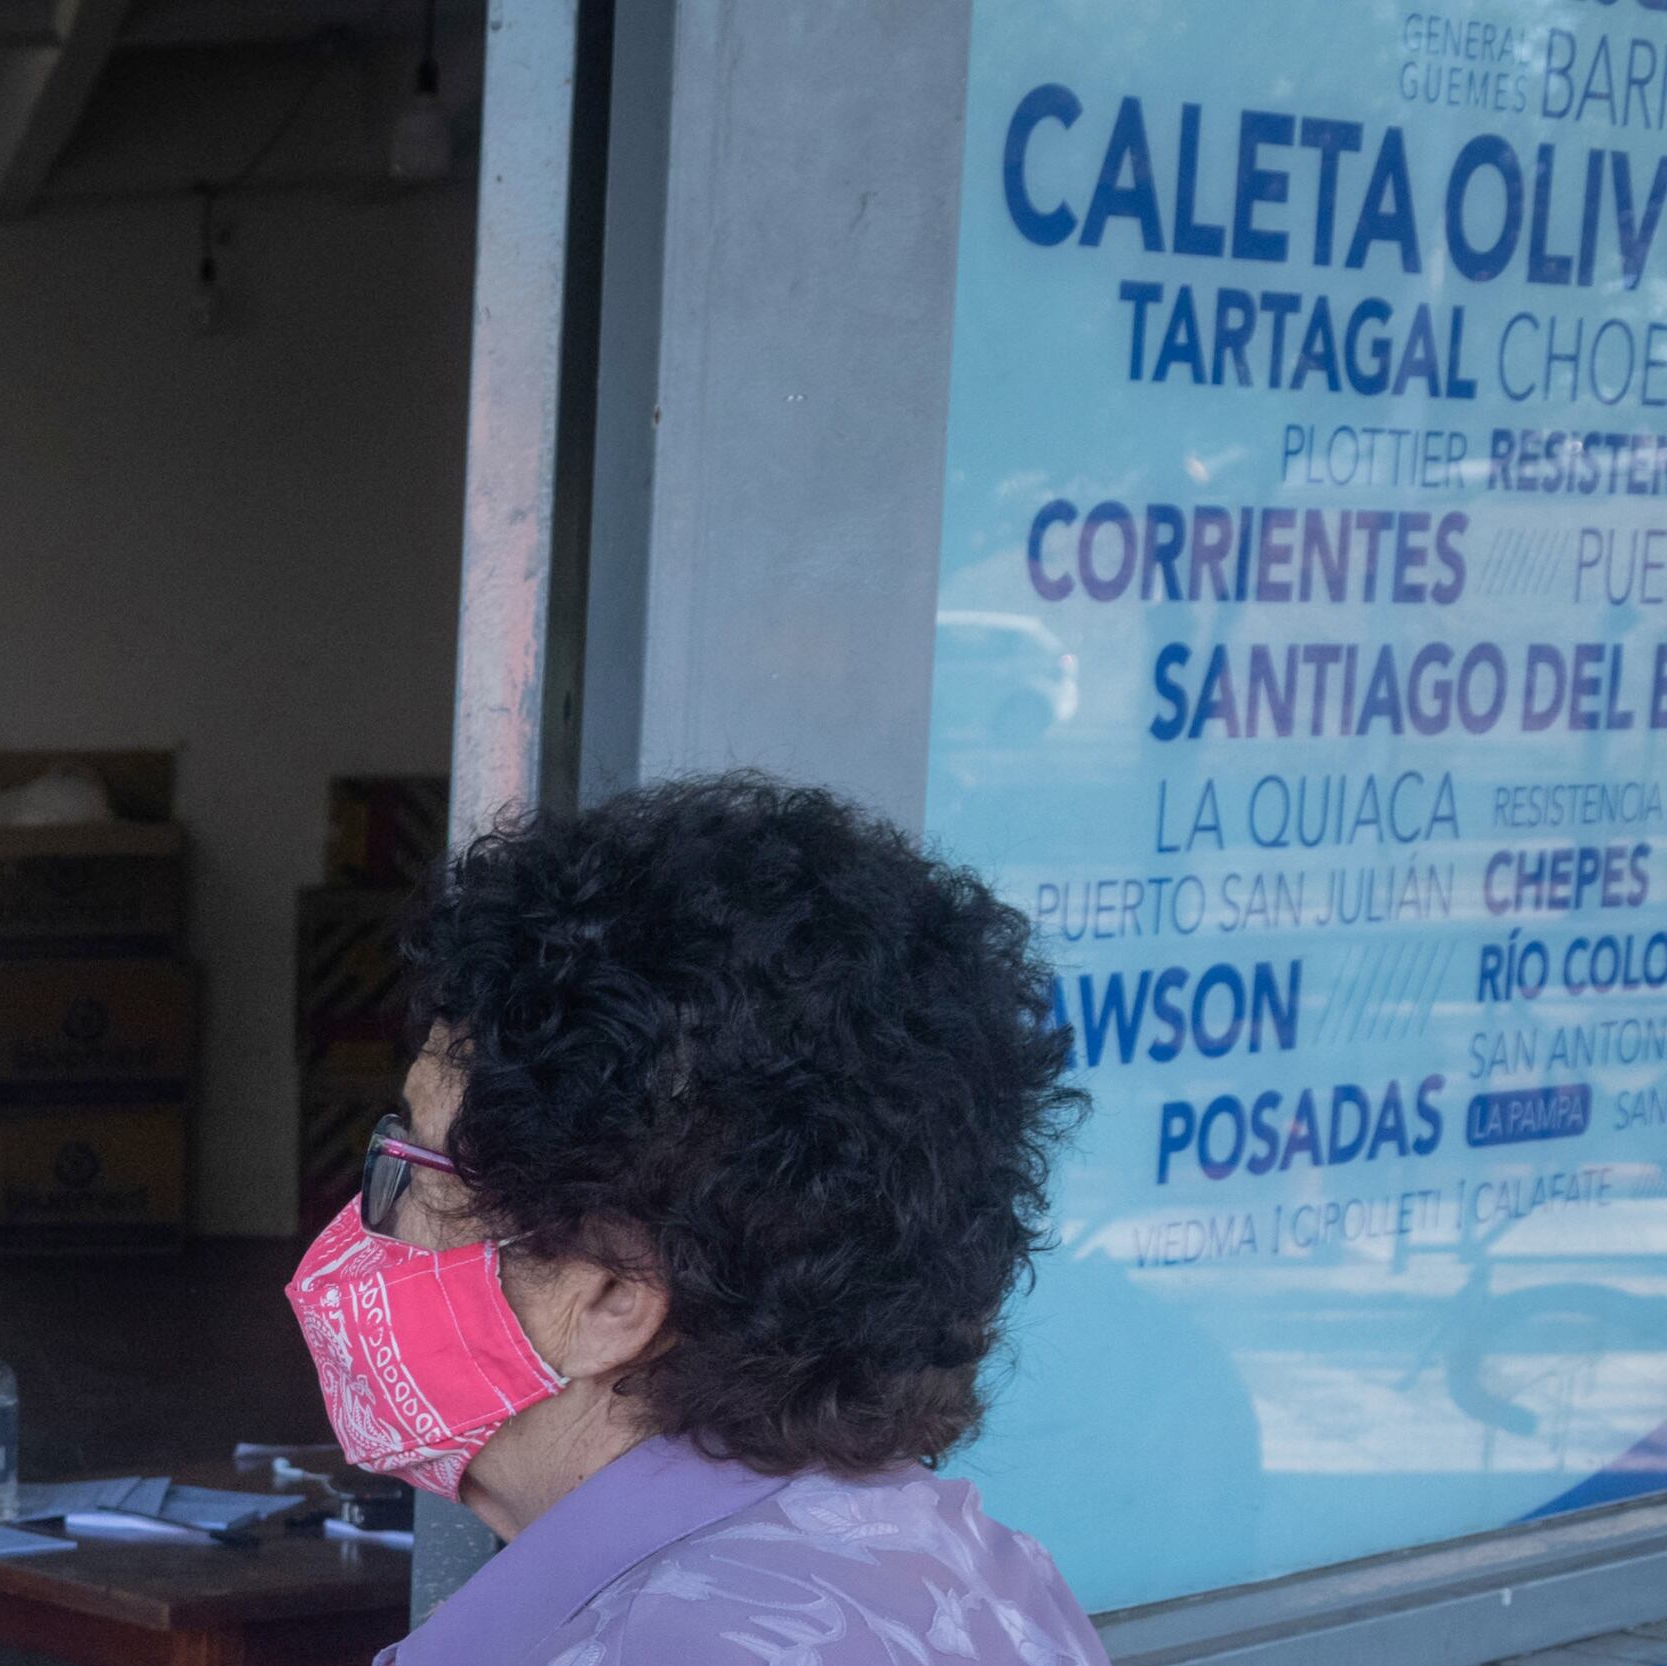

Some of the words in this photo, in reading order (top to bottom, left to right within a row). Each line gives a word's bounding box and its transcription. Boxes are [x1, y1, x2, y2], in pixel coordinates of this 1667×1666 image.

[1541, 27, 1667, 131] BAR
[1002, 82, 1422, 275] CALETA
[1444, 132, 1667, 291] OLIV
[1118, 279, 1478, 399] TARTAGAL
[1282, 423, 1467, 488] PLOTTIER
[1026, 498, 1470, 606] CORRIENTES
[1148, 640, 1509, 742] SANTIAGO
[1521, 642, 1635, 732] DEL
[1156, 777, 1226, 854] LA
[1248, 770, 1461, 848] QUIACA
[1493, 782, 1663, 829] RESISTENCIA
[1036, 873, 1206, 942] PUERTO
[1219, 871, 1306, 933] SAN
[1315, 851, 1455, 928] JULIÁN
[1483, 842, 1652, 916] CHEPES
[1477, 926, 1550, 1003] RÍO
[1053, 958, 1304, 1068] WSON
[1468, 1026, 1539, 1080] SAN
[1156, 1072, 1447, 1185] POSADAS
[1473, 1102, 1505, 1140] LA
[1509, 1094, 1587, 1134] PAMPA
[1133, 1213, 1259, 1268] VIEDMA
[1290, 1190, 1443, 1249] CIPOLLETI
[1472, 1167, 1615, 1224] CALAFATE
